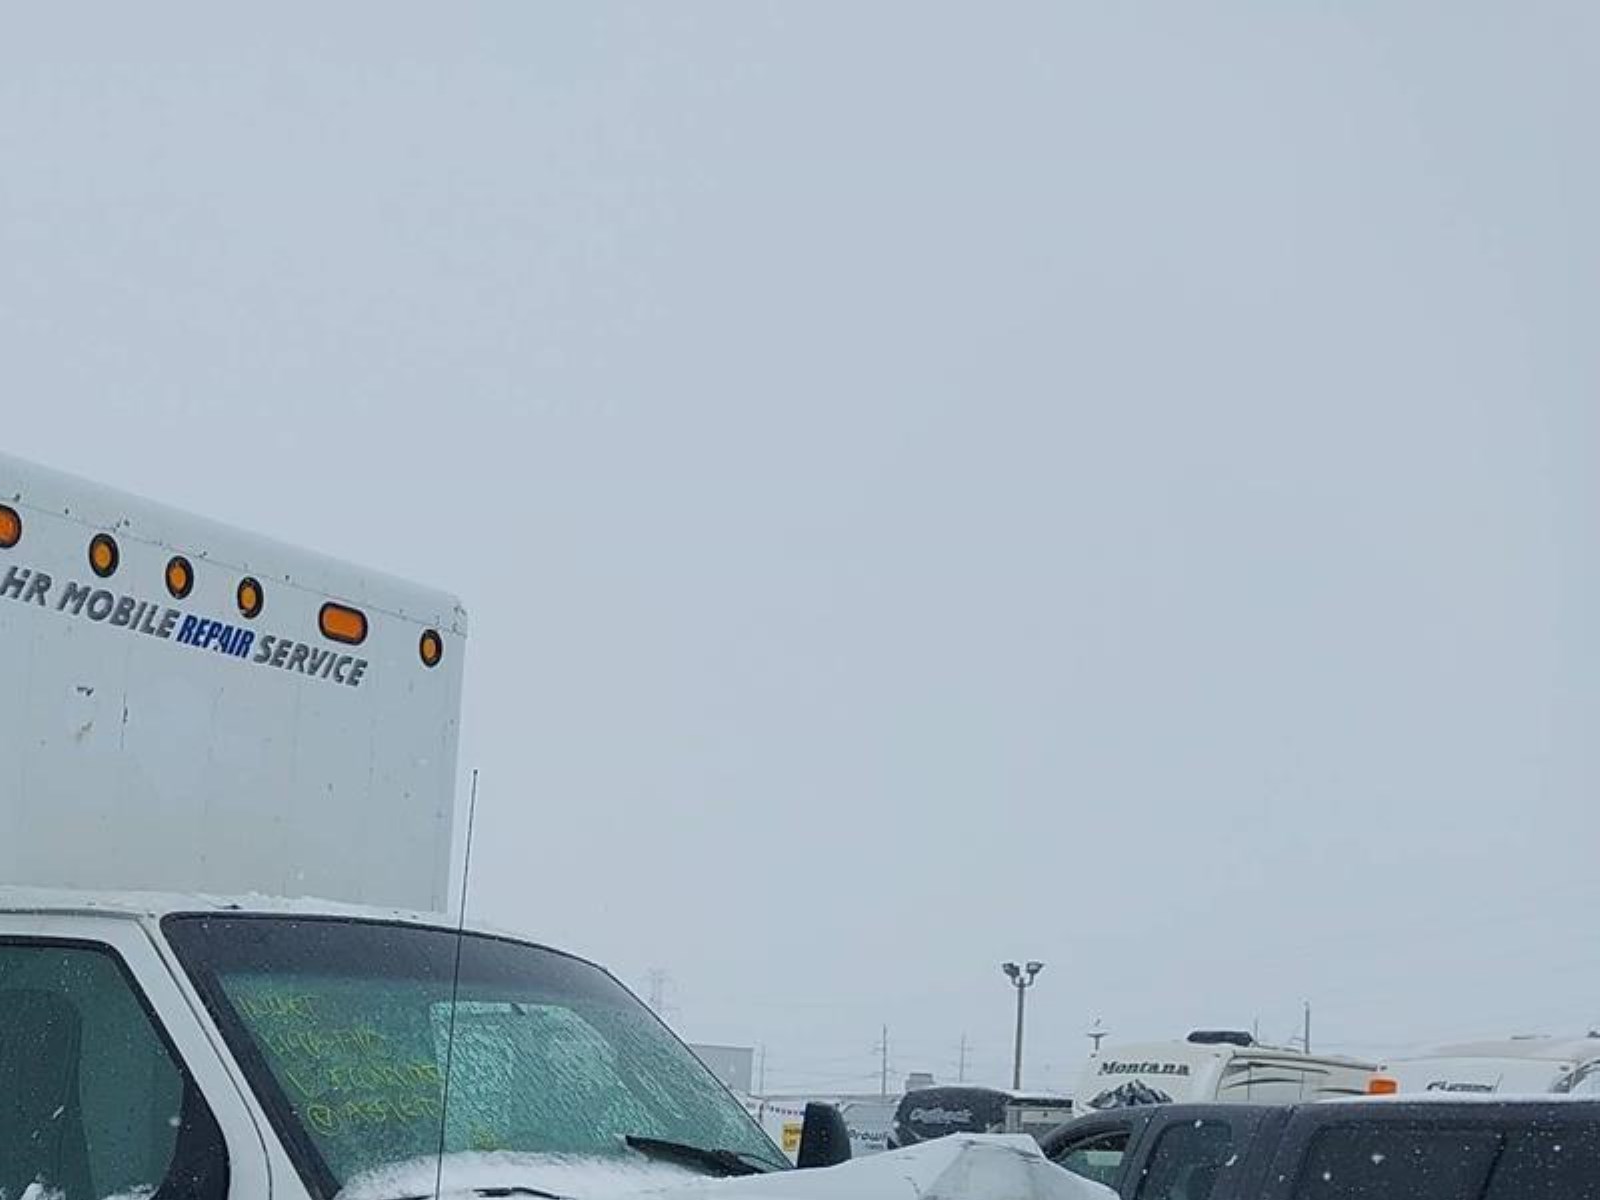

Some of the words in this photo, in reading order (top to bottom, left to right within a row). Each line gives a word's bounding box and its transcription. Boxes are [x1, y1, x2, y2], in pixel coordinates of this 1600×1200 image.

[57, 583, 182, 641] MOBILE
[176, 613, 256, 660] REPAIR
[253, 633, 369, 688] SERVICE
[1098, 1061, 1189, 1076] Montana
